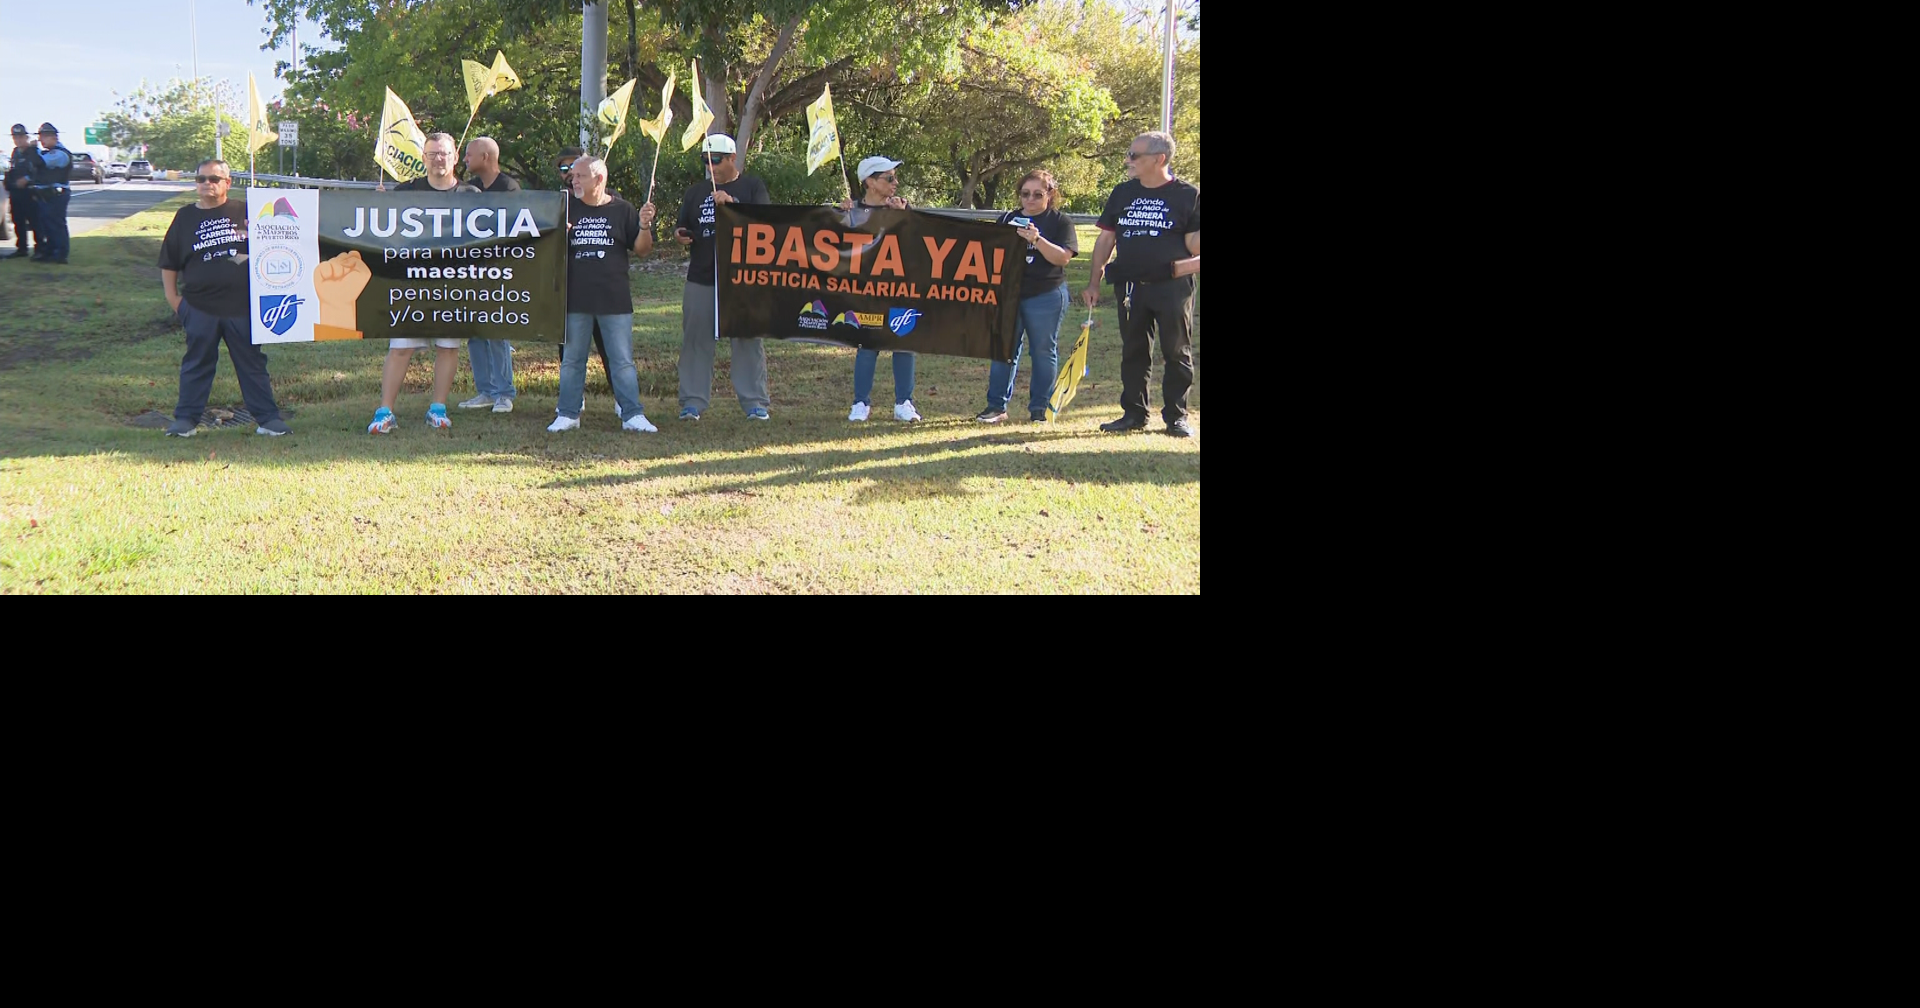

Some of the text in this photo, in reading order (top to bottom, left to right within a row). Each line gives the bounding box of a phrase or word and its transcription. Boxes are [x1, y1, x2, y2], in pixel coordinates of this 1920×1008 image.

[343, 206, 541, 238] JUSTICIA
[1126, 210, 1164, 220] CARRERA
[200, 228, 237, 241] CARRERA
[213, 223, 231, 231] PAGO
[574, 229, 608, 238] CARRERA
[193, 234, 246, 251] MAGISTERIAL?
[383, 244, 536, 263] para nuestros
[730, 223, 1005, 285] ¡BASTA YA!
[407, 264, 514, 280] maestros
[389, 284, 532, 305] pensionados
[731, 268, 998, 306] JUSTICIA SALARIAL AHORA
[263, 295, 305, 330] aft
[389, 305, 531, 327] y/o retirados
[858, 314, 883, 322] AMPR
[890, 308, 923, 333] aft
